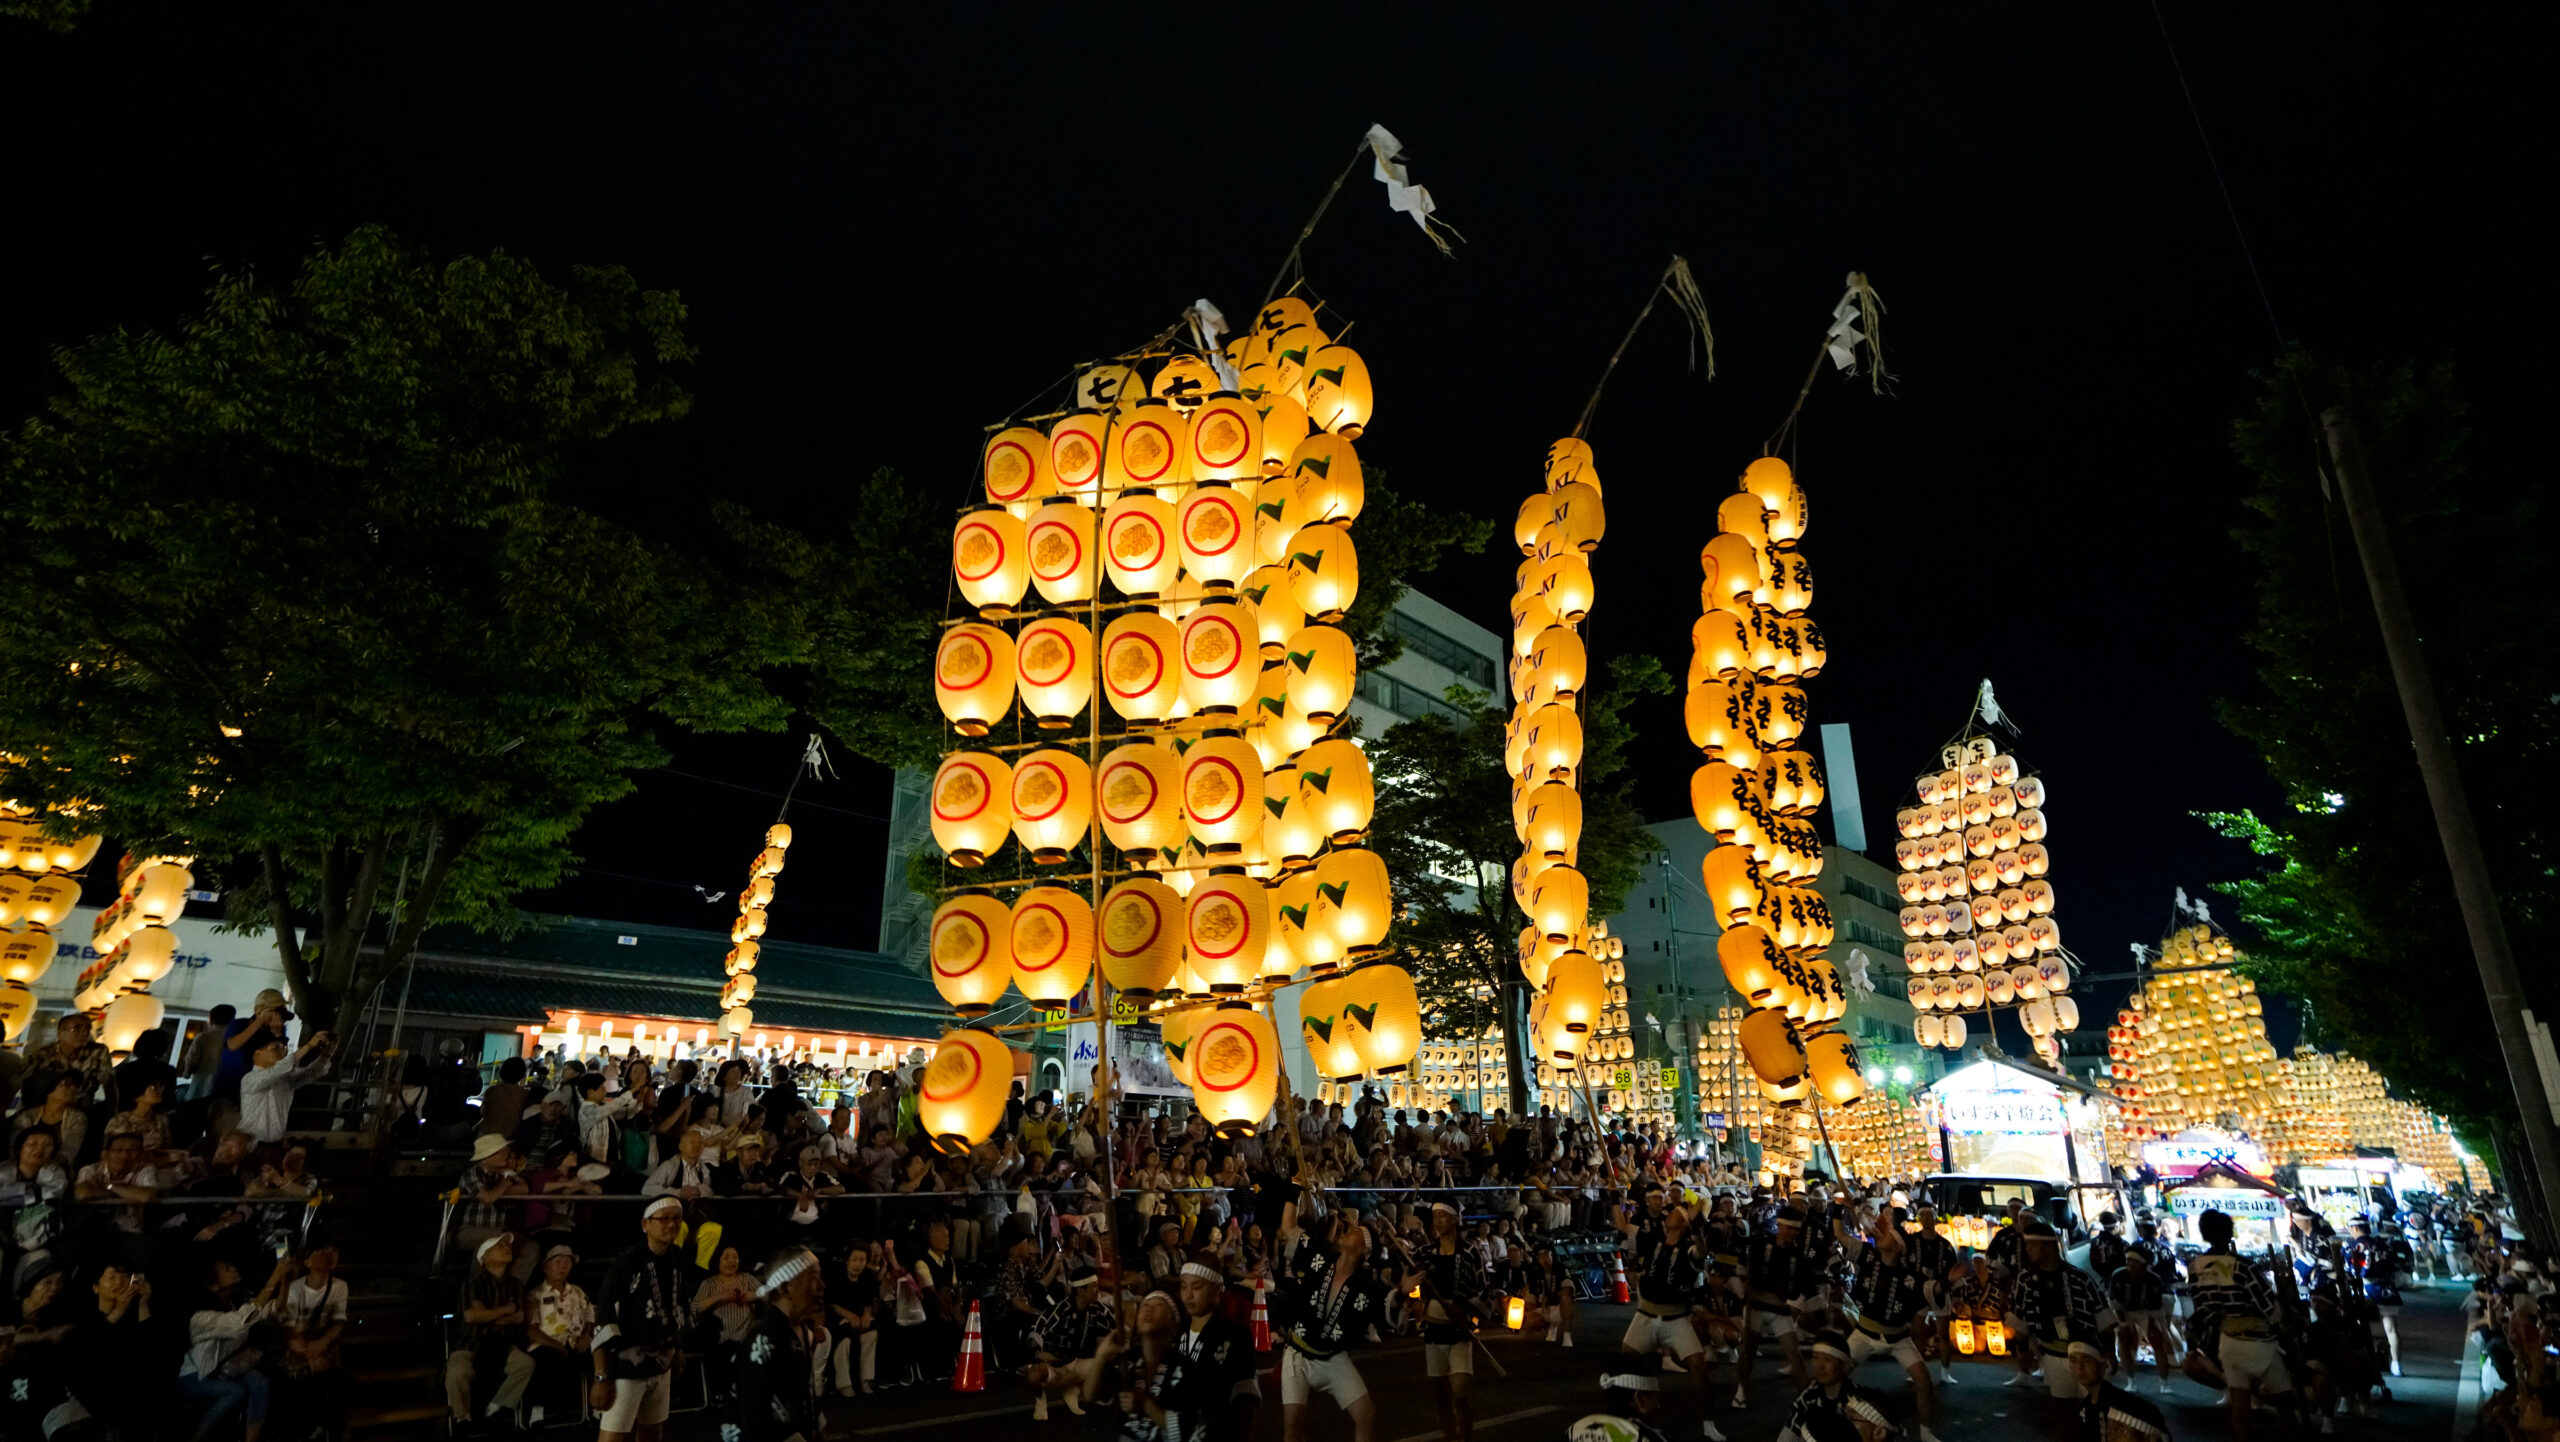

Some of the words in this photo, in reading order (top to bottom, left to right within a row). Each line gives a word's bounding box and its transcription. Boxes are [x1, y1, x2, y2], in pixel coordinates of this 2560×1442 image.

[1073, 1038, 1099, 1061] Asa
[1615, 1072, 1631, 1084] 68
[1661, 1070, 1676, 1083] 67
